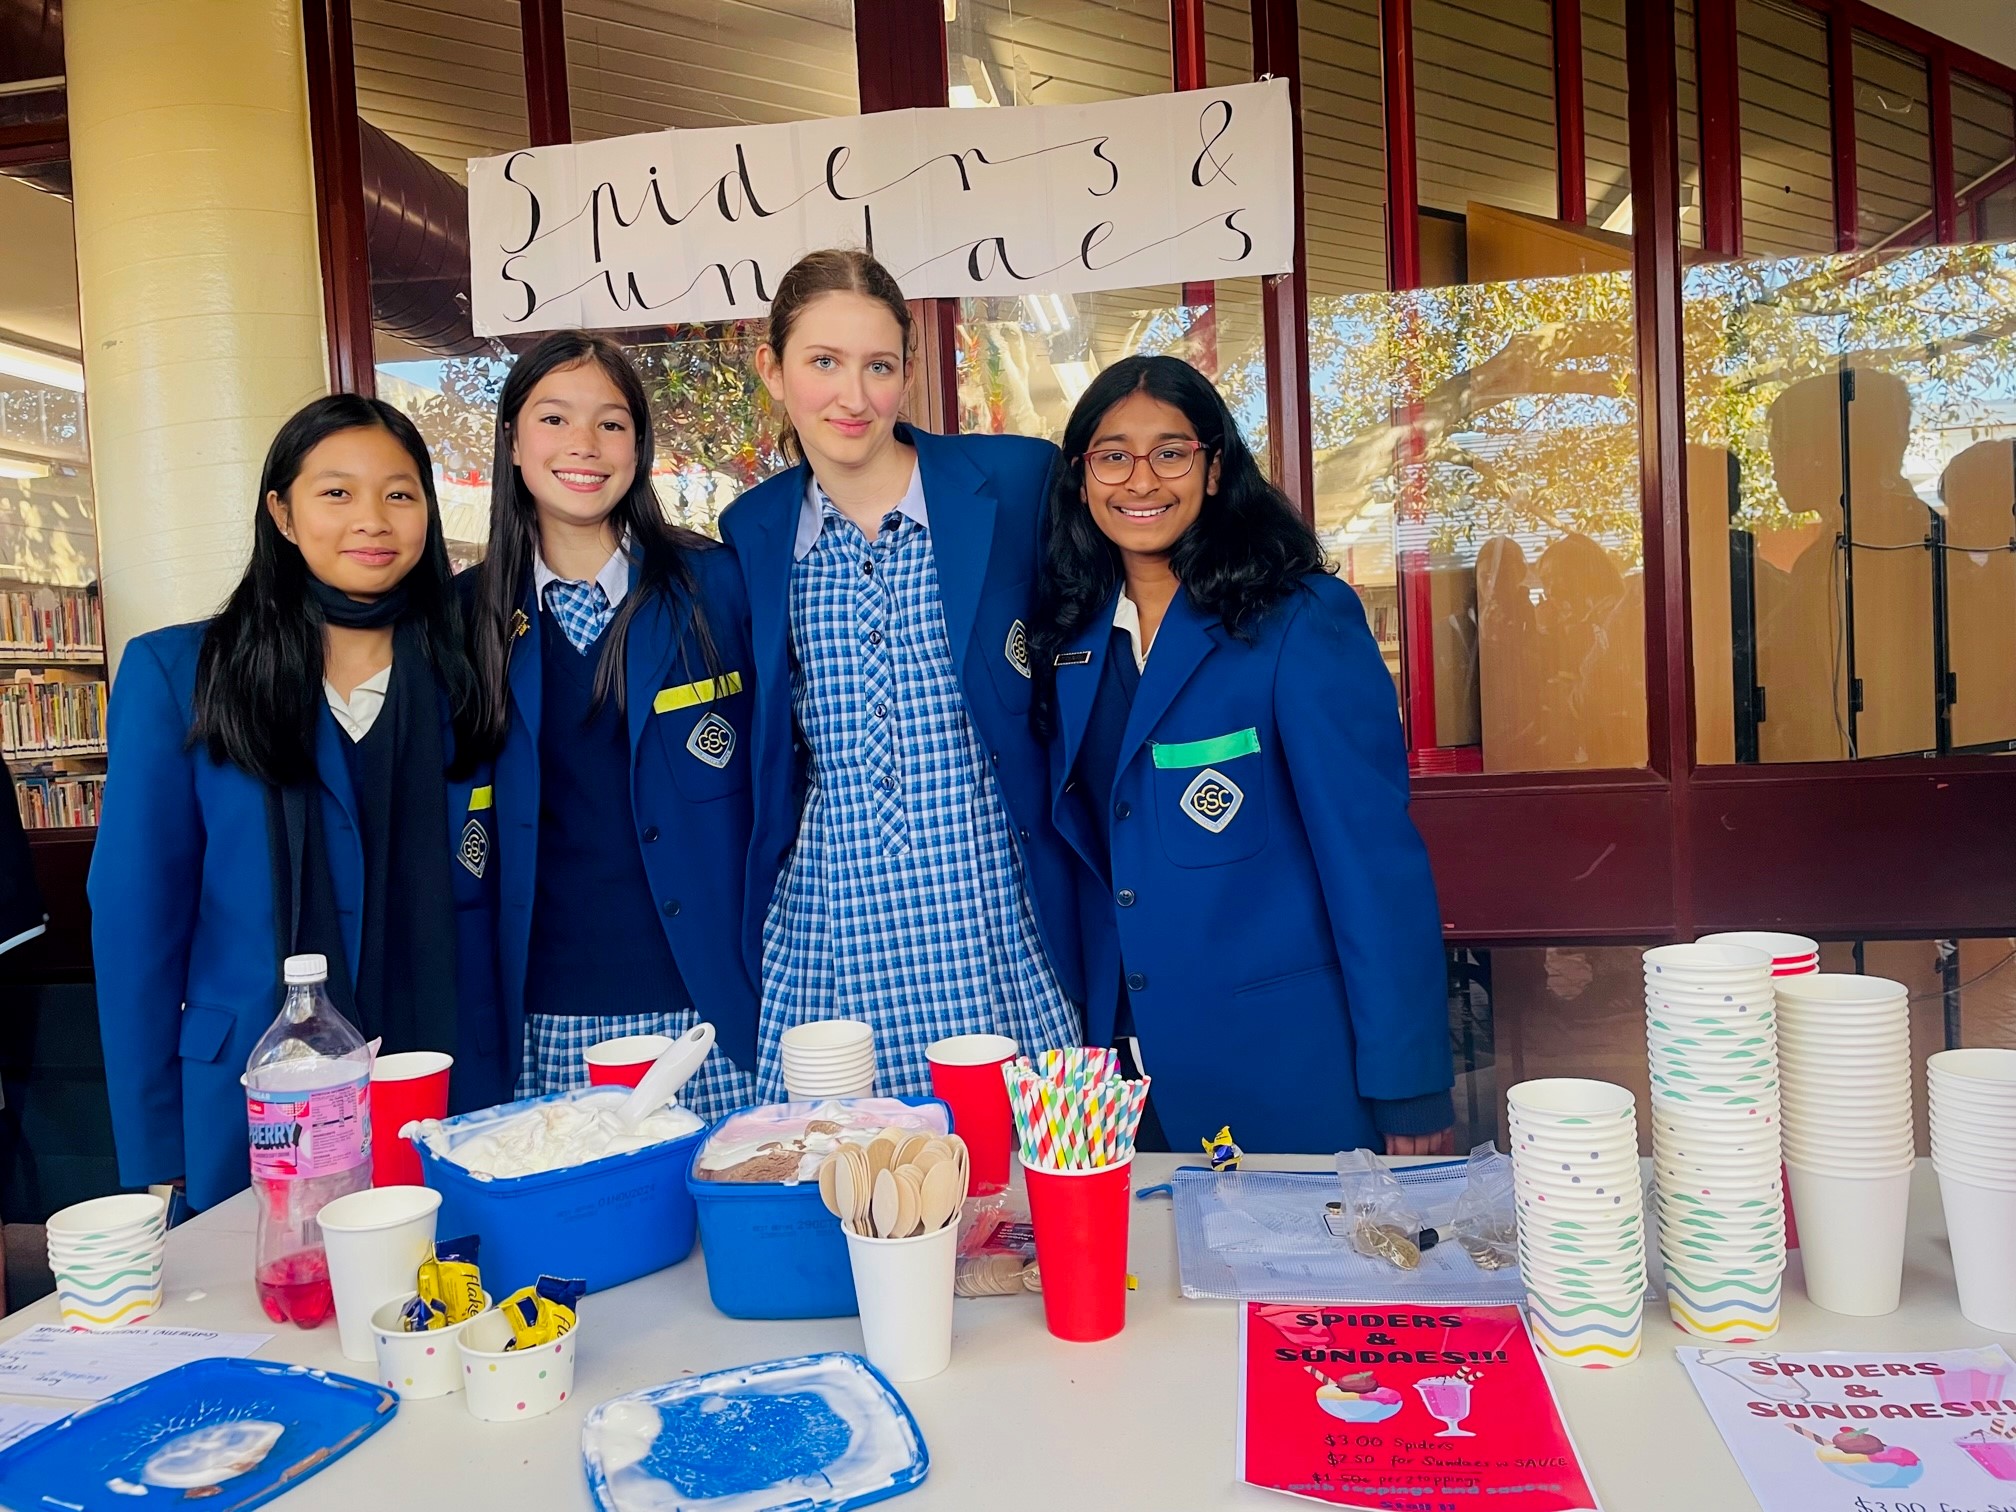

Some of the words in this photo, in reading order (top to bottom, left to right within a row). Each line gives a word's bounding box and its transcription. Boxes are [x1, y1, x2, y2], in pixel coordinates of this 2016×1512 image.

[500, 136, 1118, 262] Spiders
[1191, 100, 1237, 187] &
[1296, 1313, 1463, 1329] SPIDERS
[1366, 1331, 1397, 1345] &
[1275, 1348, 1509, 1365] SUNDAES!!!
[1748, 1361, 1946, 1378] SPIDERS
[1844, 1384, 1883, 1398] &
[1747, 1400, 2016, 1419] SUNDAES!!!
[1391, 1455, 1414, 1467] for
